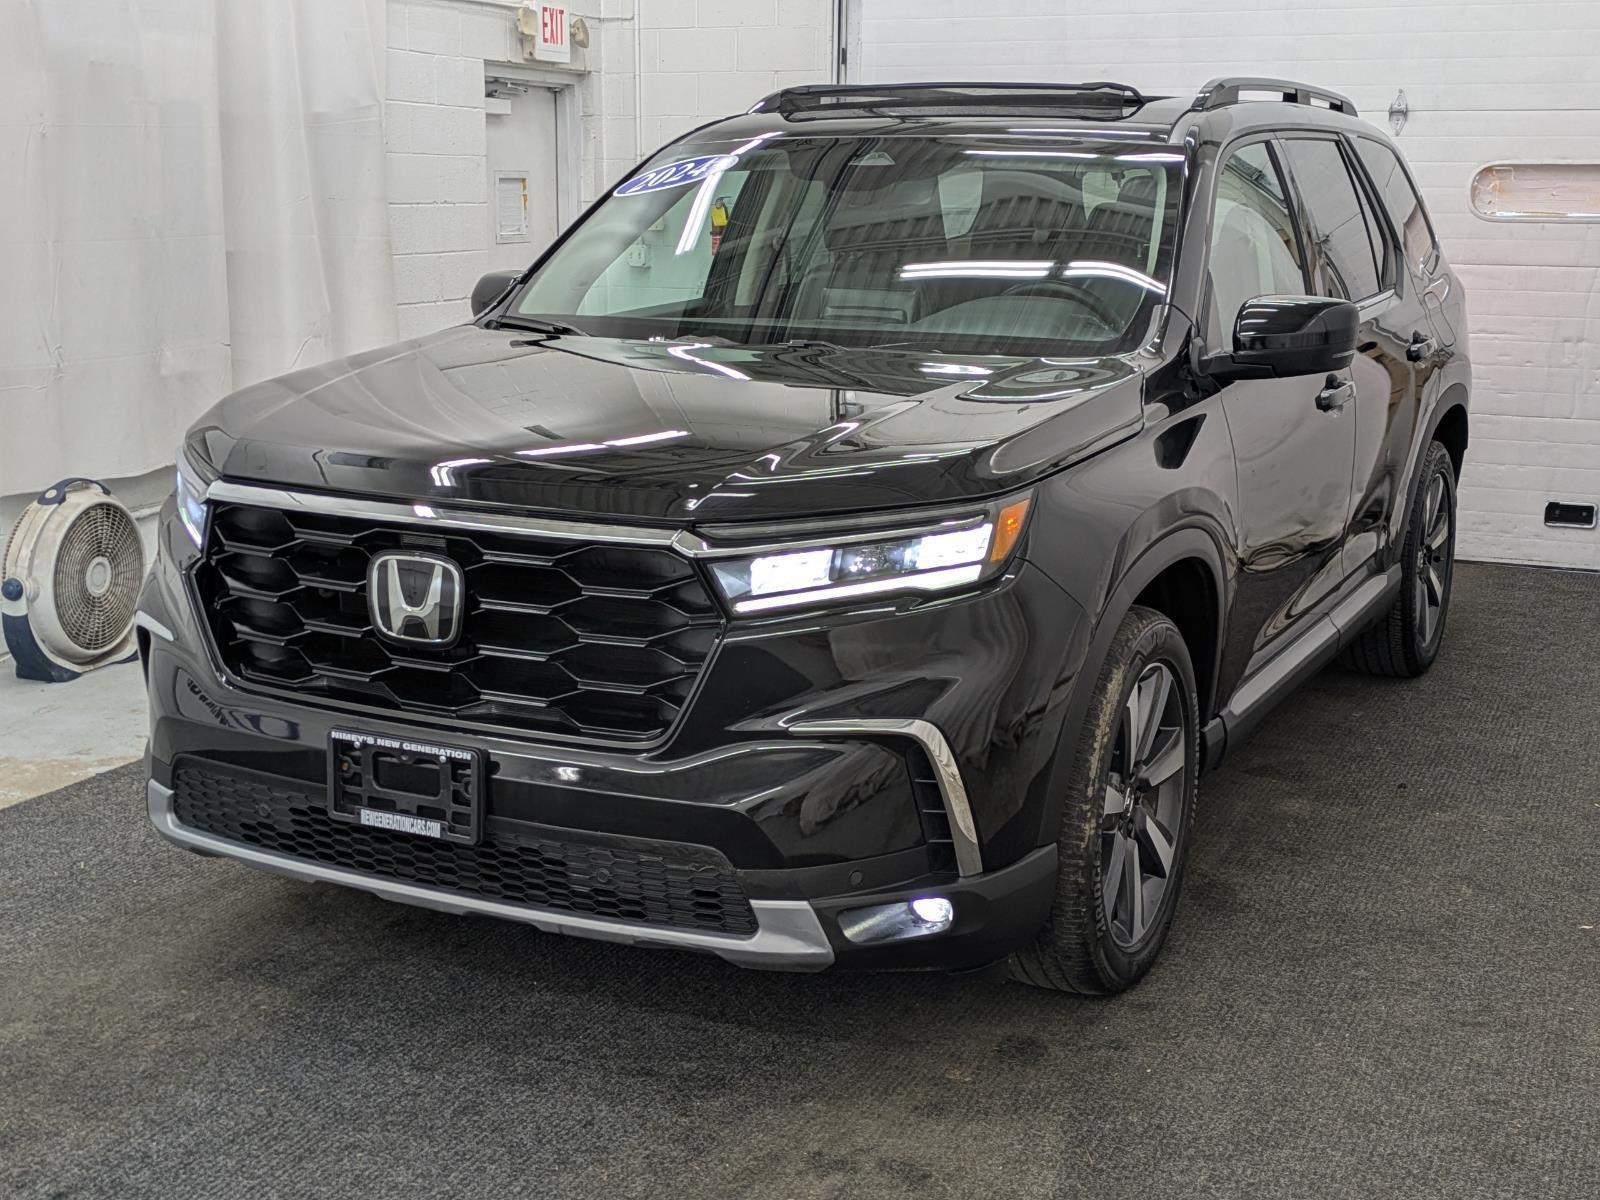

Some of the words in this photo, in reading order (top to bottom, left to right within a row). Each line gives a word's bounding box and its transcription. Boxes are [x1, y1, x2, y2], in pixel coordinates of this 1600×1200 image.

[542, 6, 565, 46] EXIT
[624, 156, 720, 194] 2024
[331, 730, 375, 745] NIMEY'S
[377, 738, 401, 749] NEW
[402, 741, 472, 761] GENERATION
[360, 808, 441, 839] NEWGENERATIONCARS.COM
